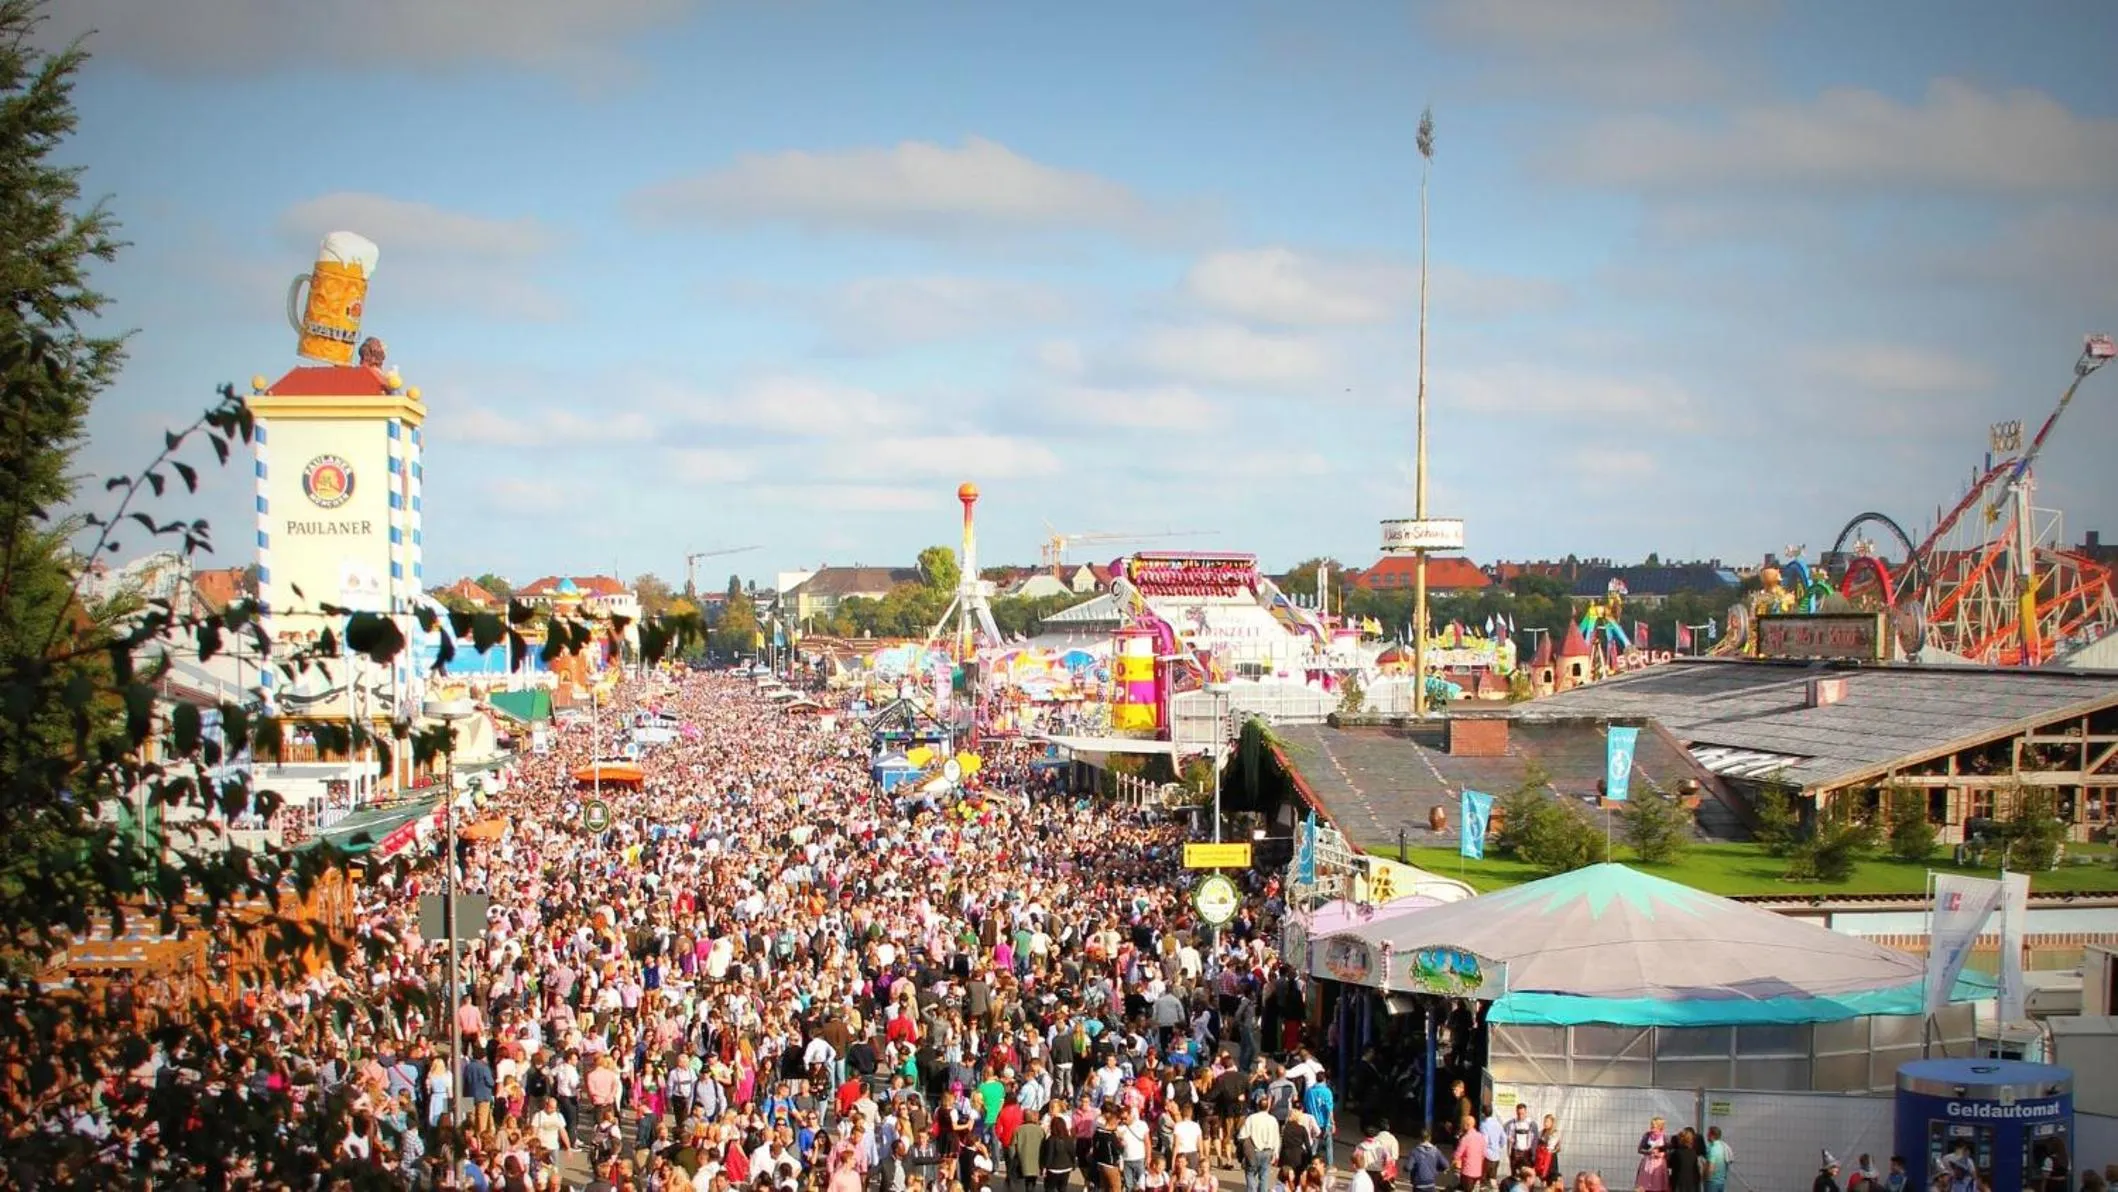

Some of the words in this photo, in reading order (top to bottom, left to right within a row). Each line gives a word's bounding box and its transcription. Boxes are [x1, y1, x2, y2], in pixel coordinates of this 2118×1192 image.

[287, 520, 372, 535] PAULANER
[1616, 650, 1683, 668] SCHLO
[1946, 1101, 2060, 1118] Geldautomat
